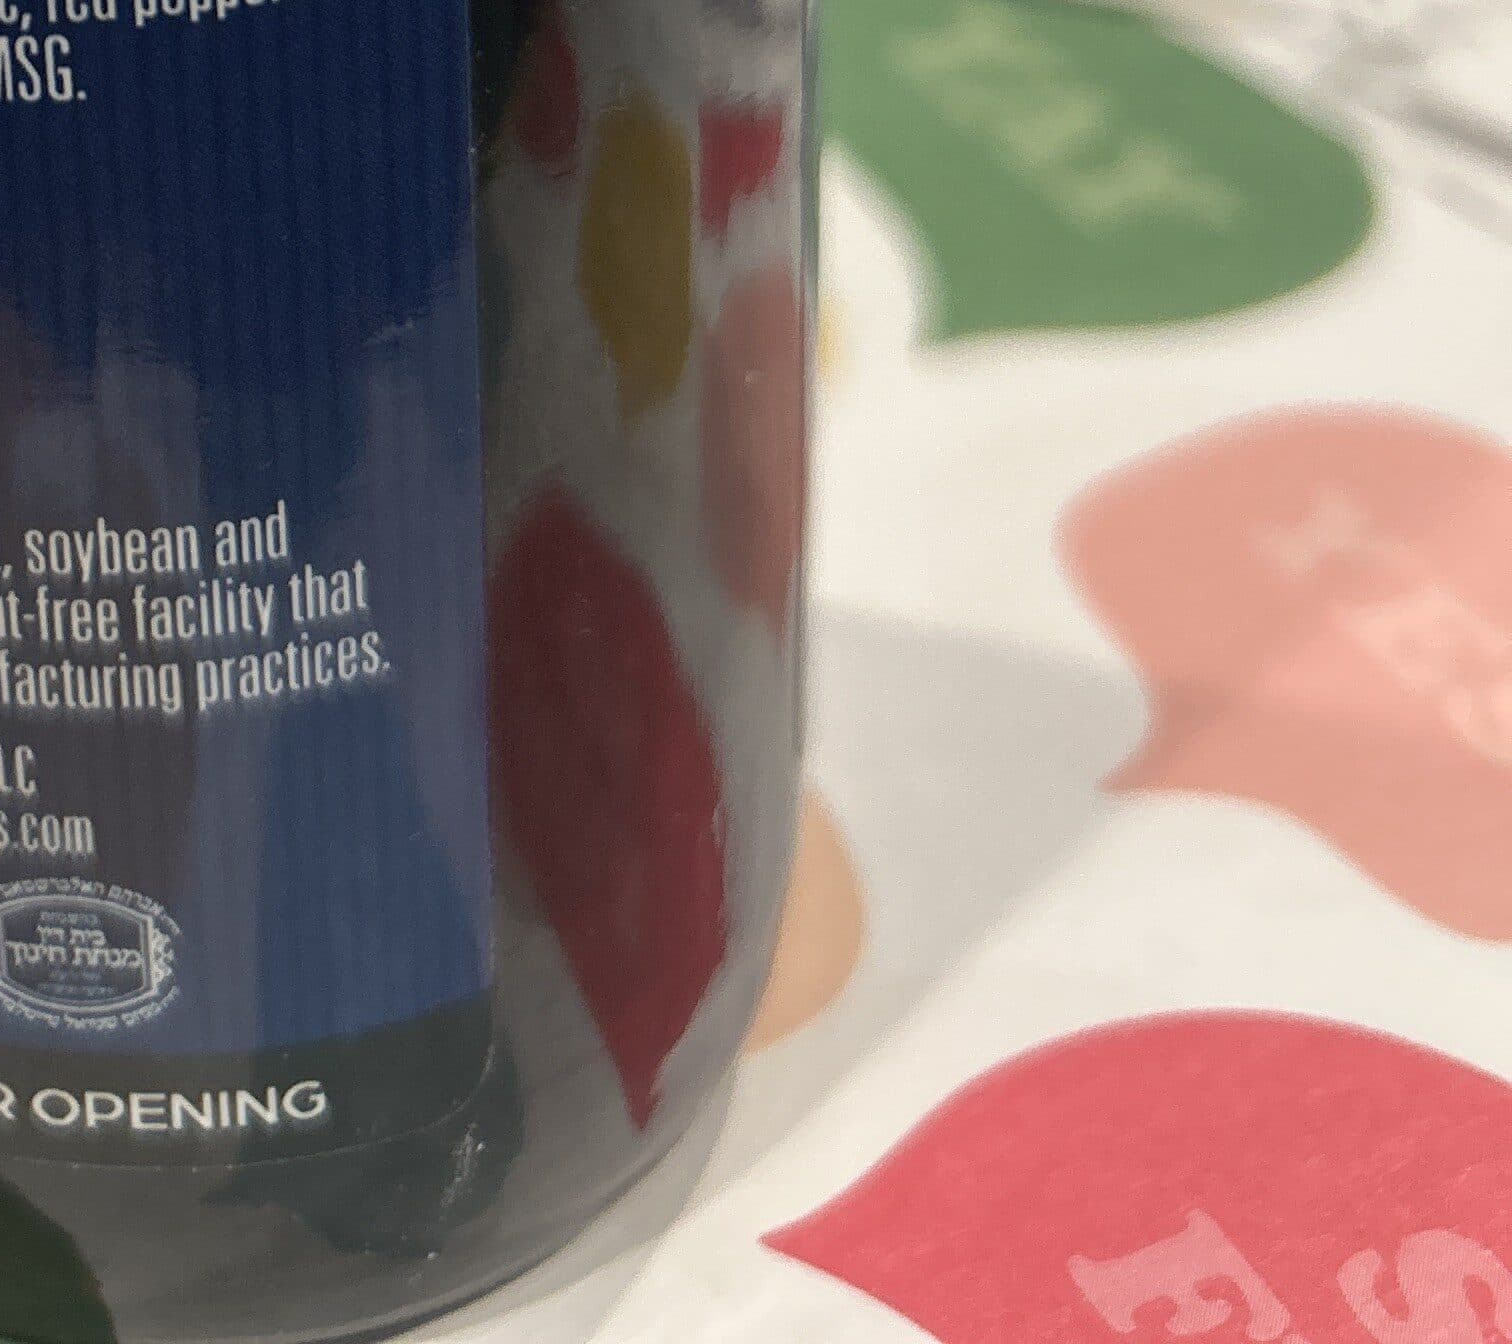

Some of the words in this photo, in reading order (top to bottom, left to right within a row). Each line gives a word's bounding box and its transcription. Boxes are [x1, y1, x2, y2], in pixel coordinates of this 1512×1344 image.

[24, 516, 200, 583] soybean
[215, 498, 289, 567] and
[132, 577, 274, 642] facility
[288, 559, 369, 625] that
[196, 629, 391, 712] practices.
[31, 1079, 328, 1131] OPENING
